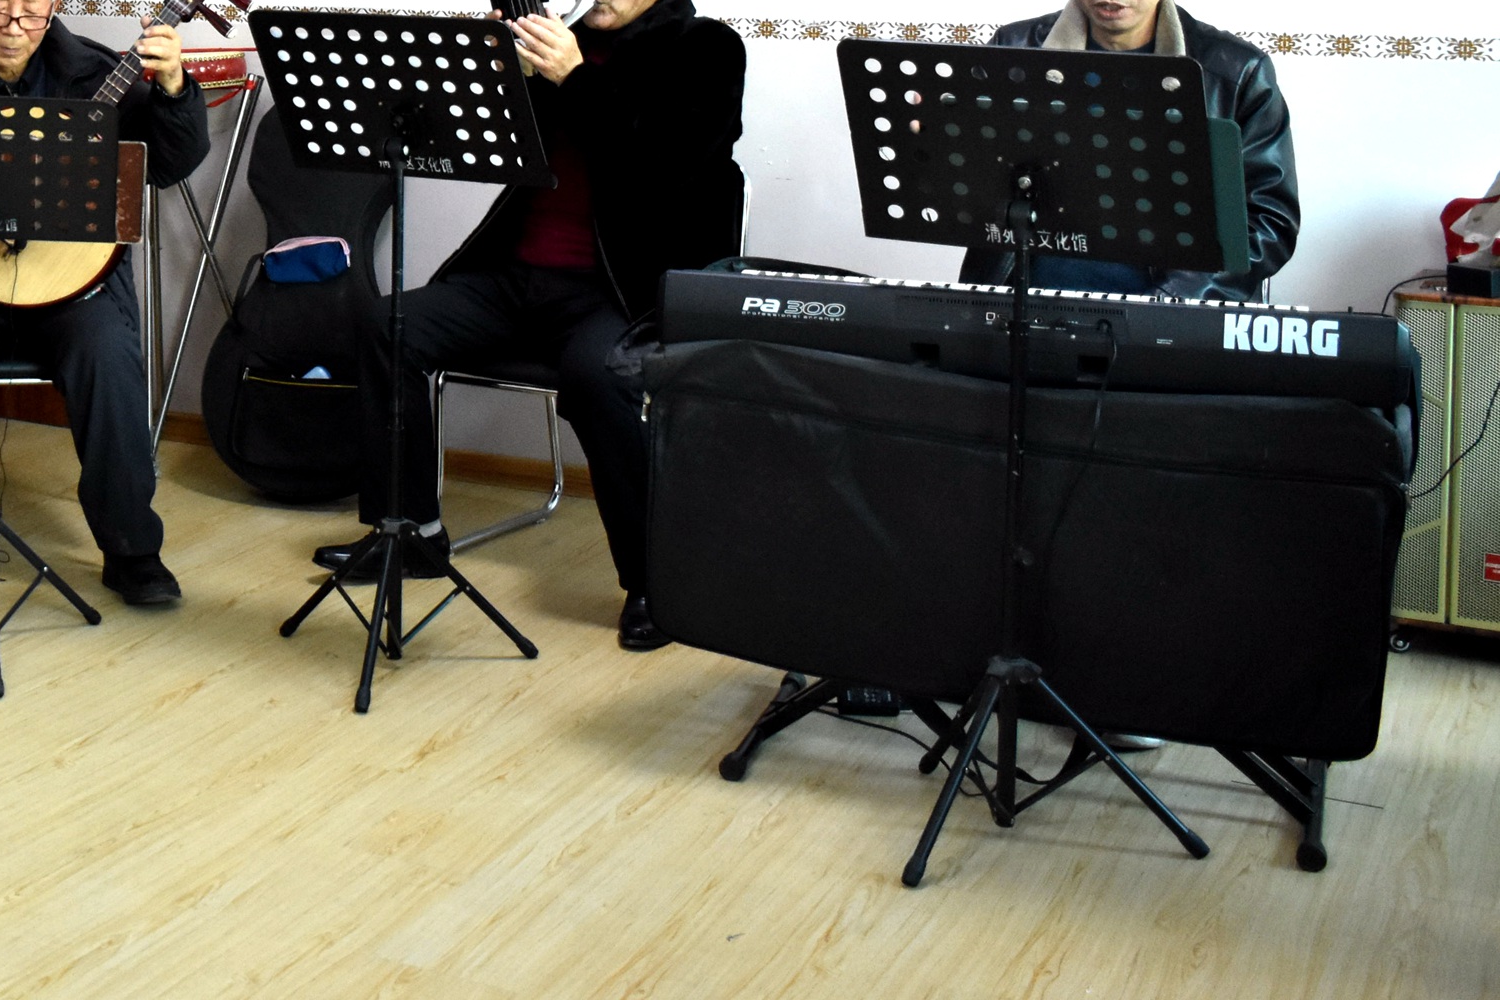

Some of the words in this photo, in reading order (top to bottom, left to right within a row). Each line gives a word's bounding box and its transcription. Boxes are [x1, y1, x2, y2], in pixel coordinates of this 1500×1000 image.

[378, 155, 454, 174] 区文化馆
[984, 222, 1088, 253] 清苑文化馆
[784, 299, 846, 318] 300
[1223, 313, 1340, 357] KORG
